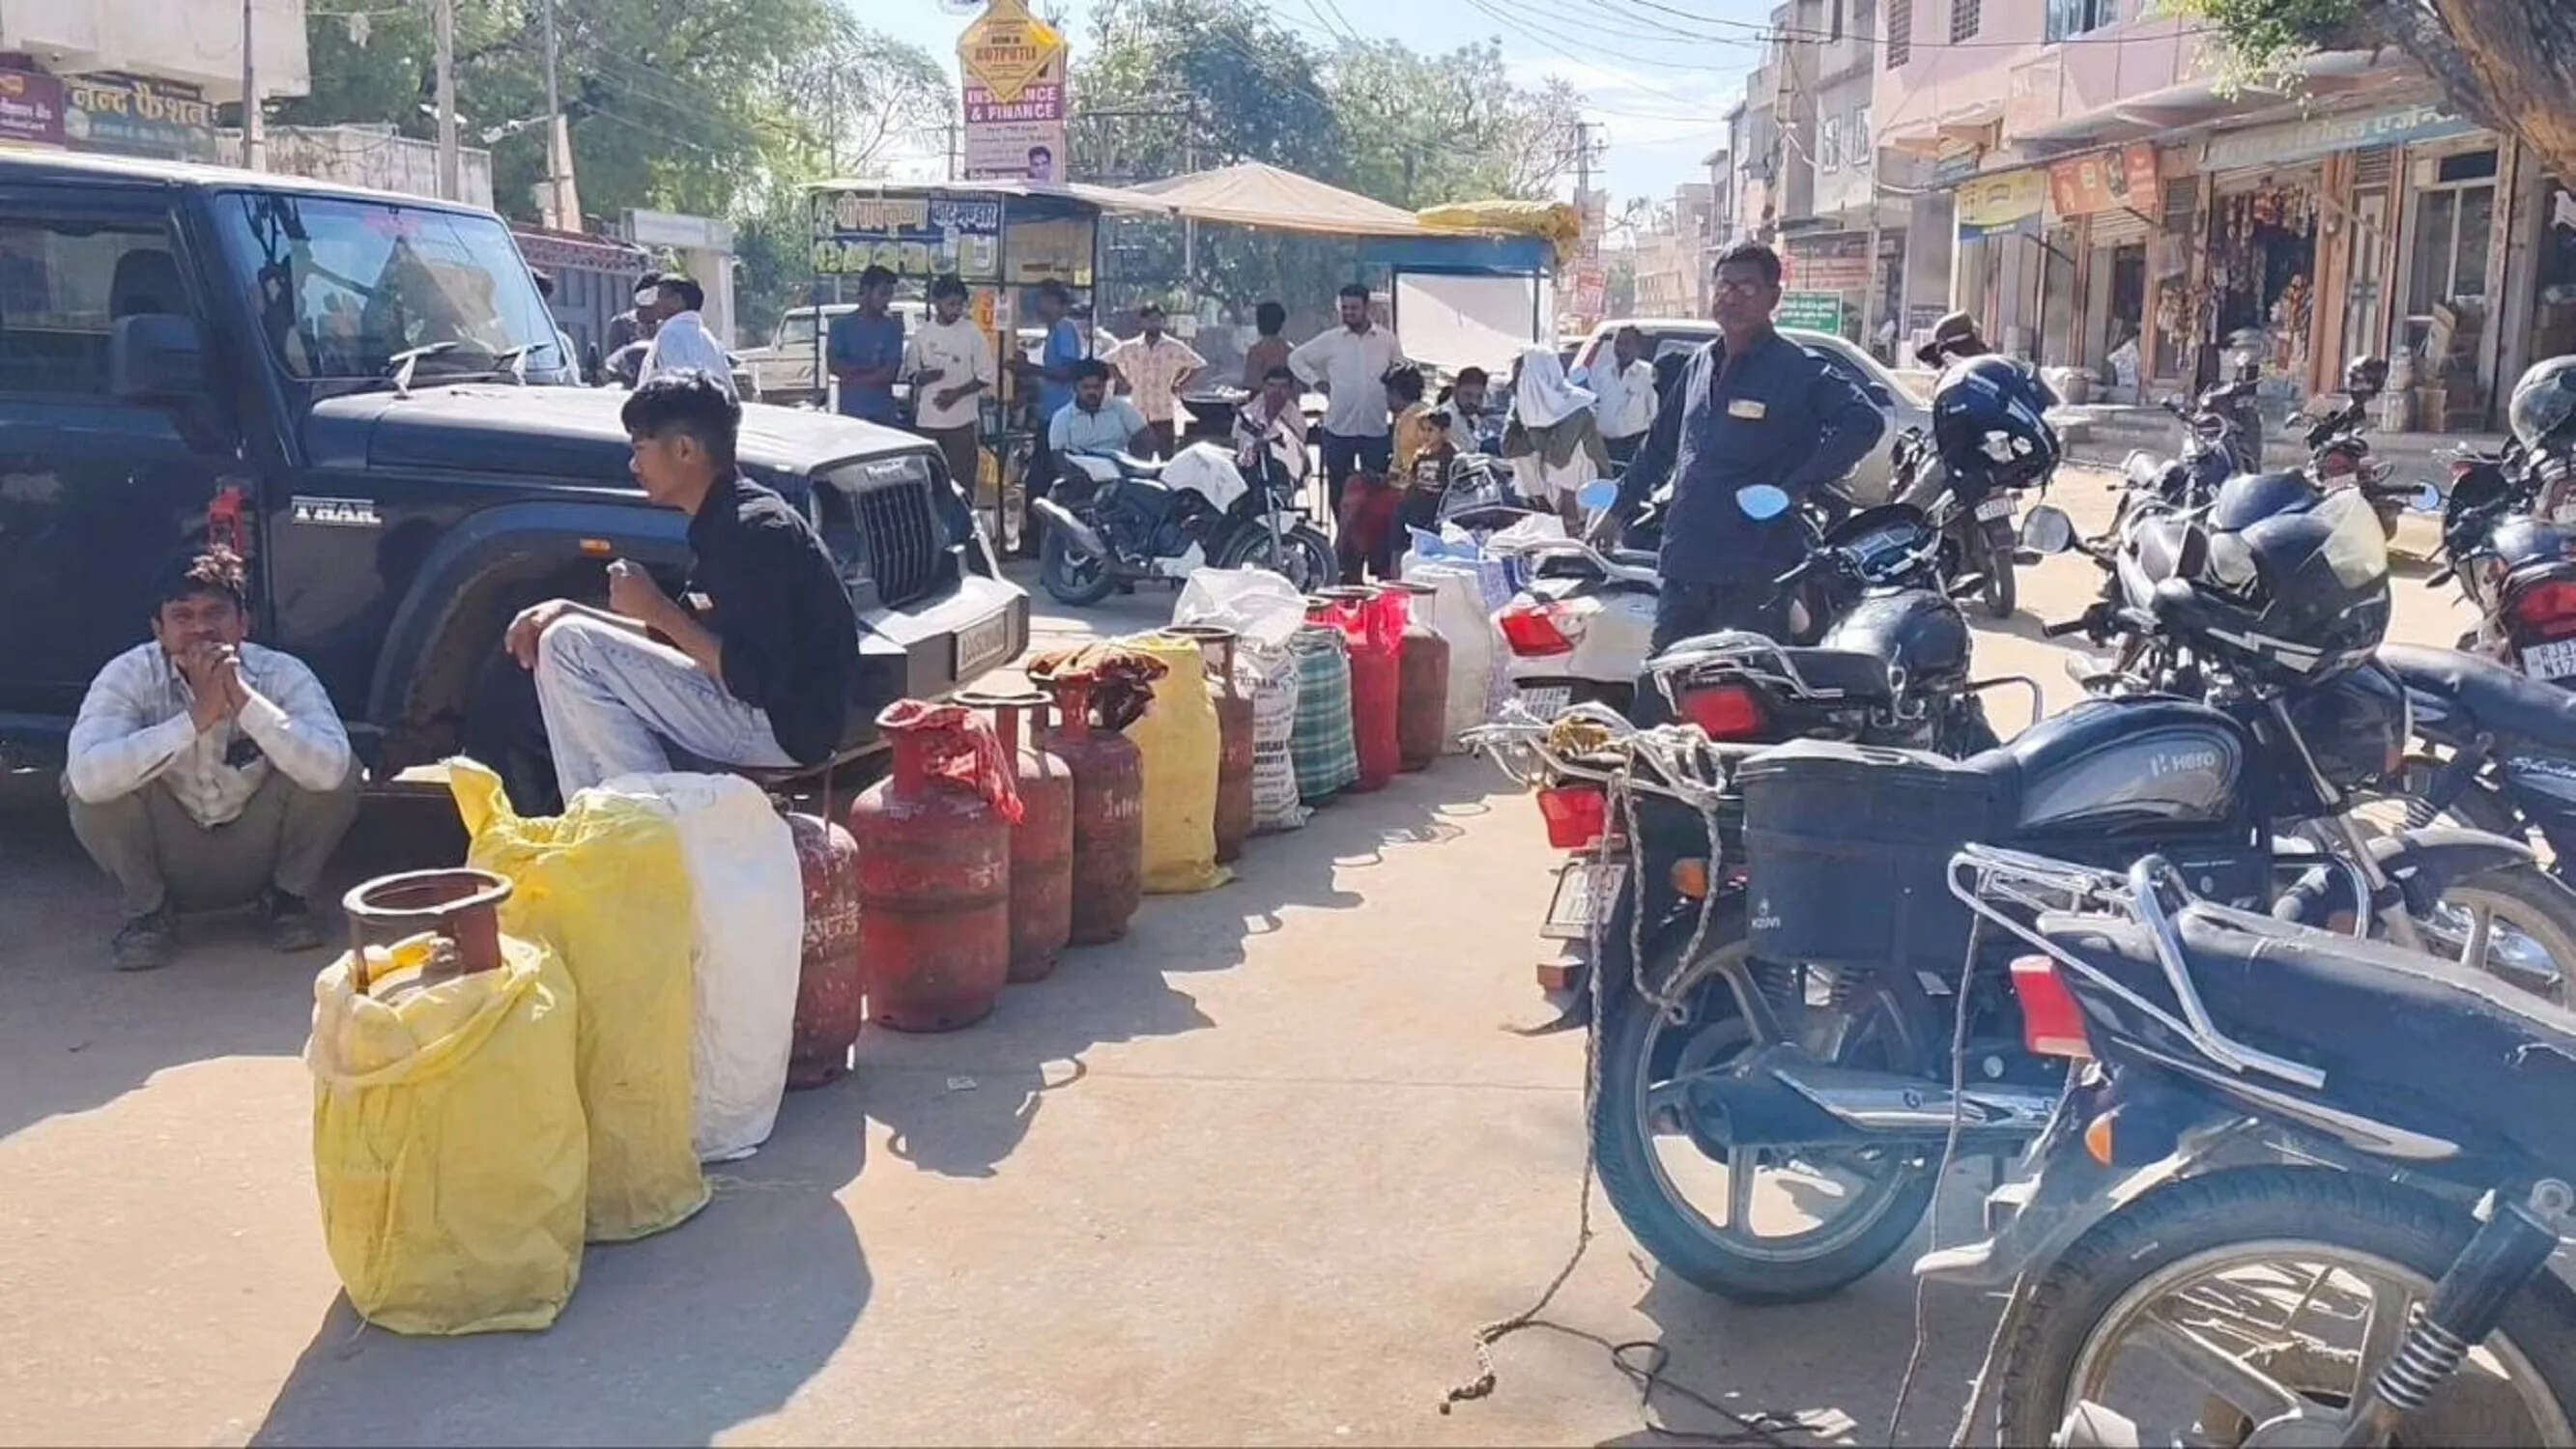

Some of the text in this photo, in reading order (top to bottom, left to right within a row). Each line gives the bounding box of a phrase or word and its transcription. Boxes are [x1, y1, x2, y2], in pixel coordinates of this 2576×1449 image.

[967, 87, 1058, 104] INSANCE
[970, 103, 1055, 121] & FINANCE
